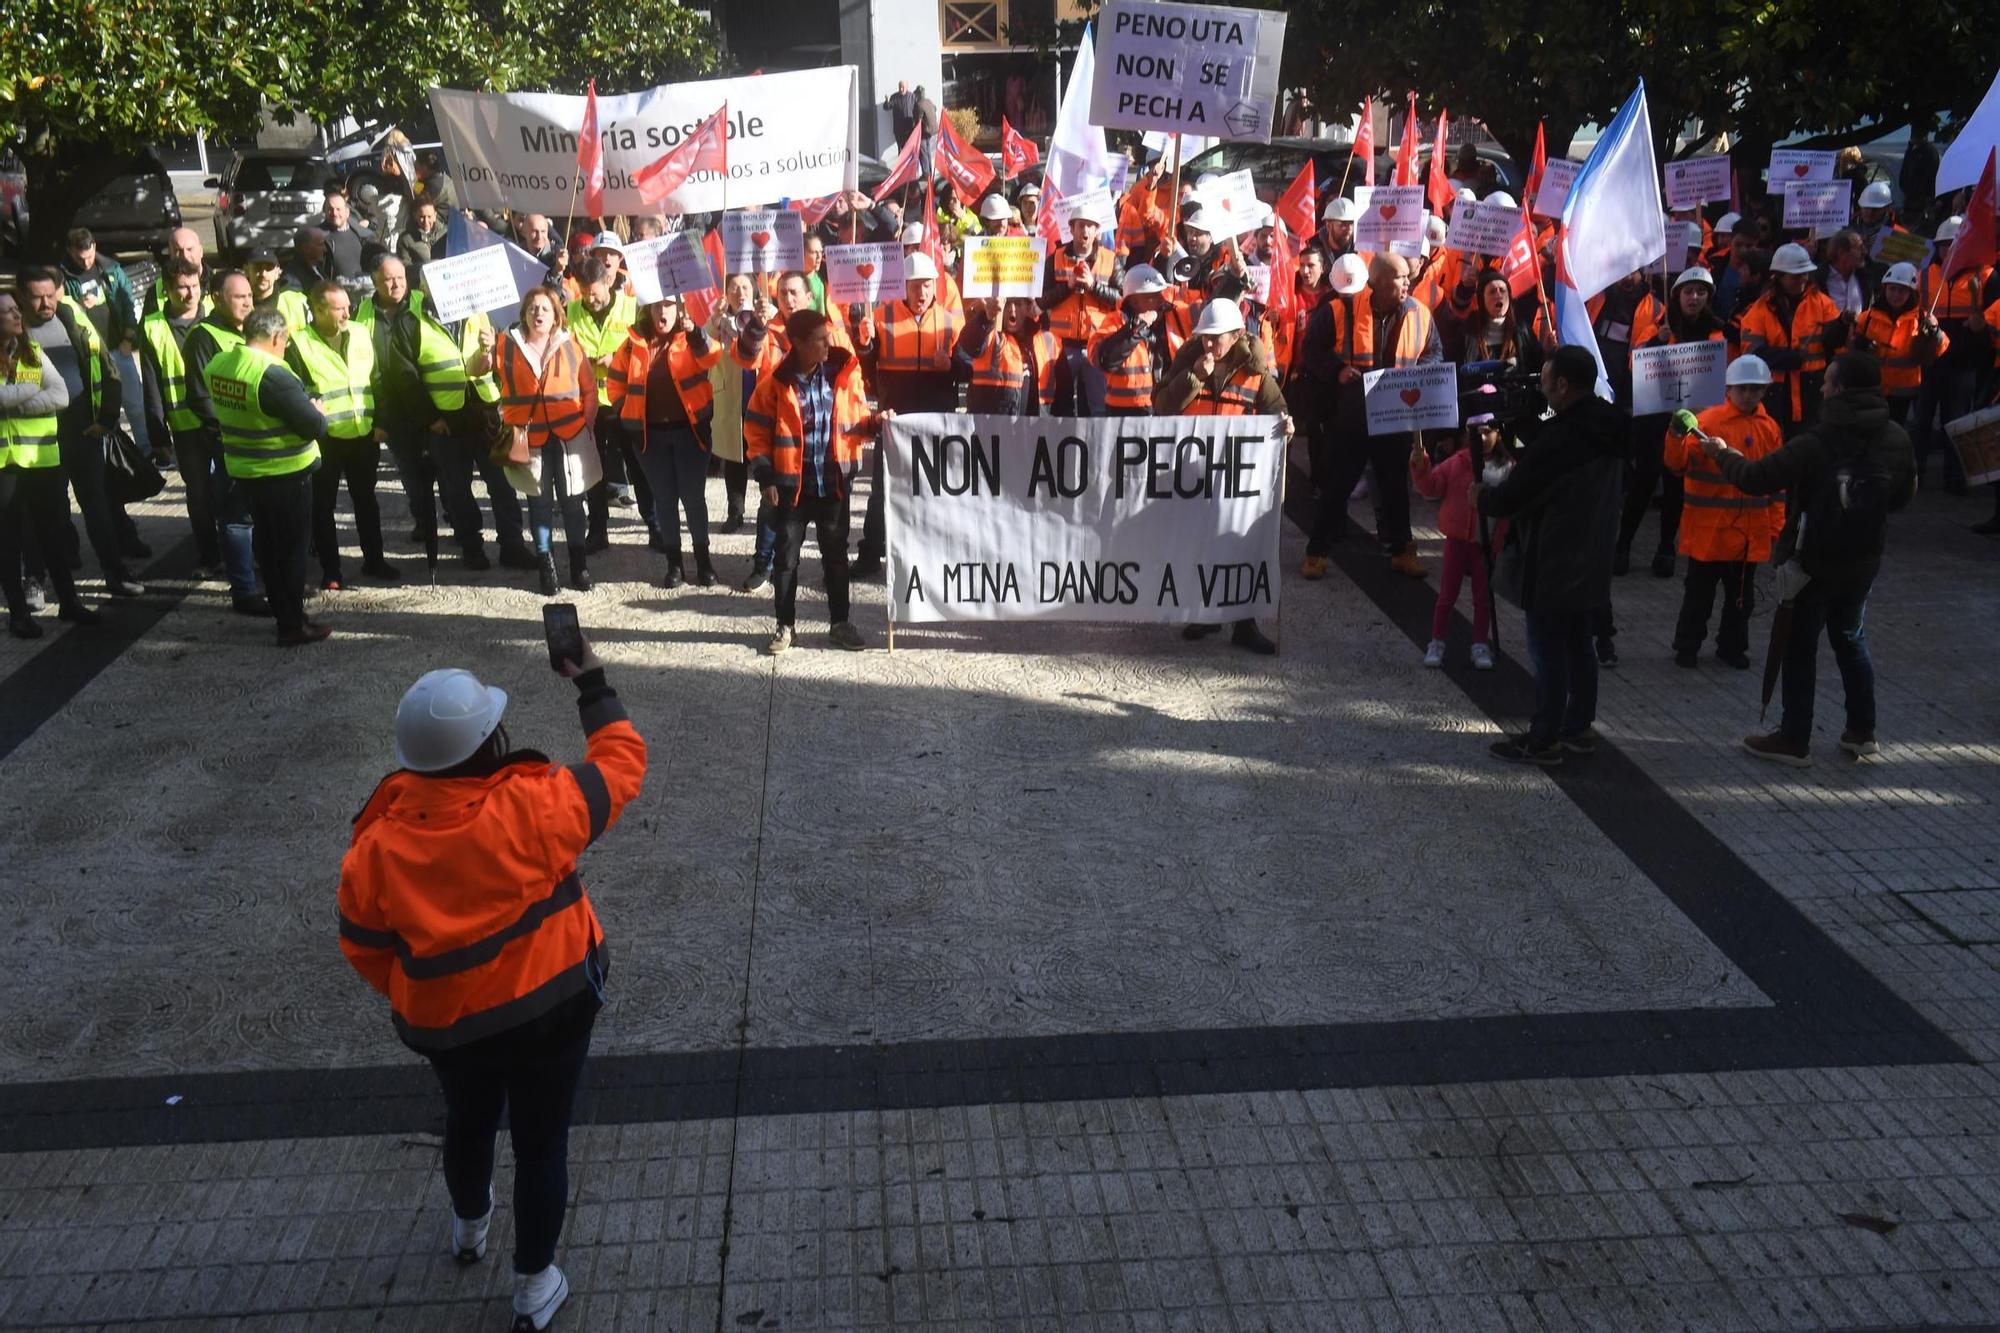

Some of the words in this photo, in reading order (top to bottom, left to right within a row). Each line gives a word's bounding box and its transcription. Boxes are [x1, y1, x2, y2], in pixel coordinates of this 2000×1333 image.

[1115, 12, 1243, 45] PENOUTA
[1116, 53, 1175, 80] NON
[1200, 63, 1230, 86] SE
[520, 121, 636, 153] Minría
[555, 178, 567, 191] o
[760, 160, 770, 175] a
[212, 378, 244, 397] CCOO
[911, 434, 999, 497] NON
[1027, 435, 1089, 498] AO
[1115, 435, 1265, 499] PECHE
[905, 564, 924, 604] A
[943, 561, 1021, 604] MINA
[1039, 560, 1141, 605] DANOS
[1157, 562, 1179, 607] A
[1197, 560, 1272, 607] VIDA
